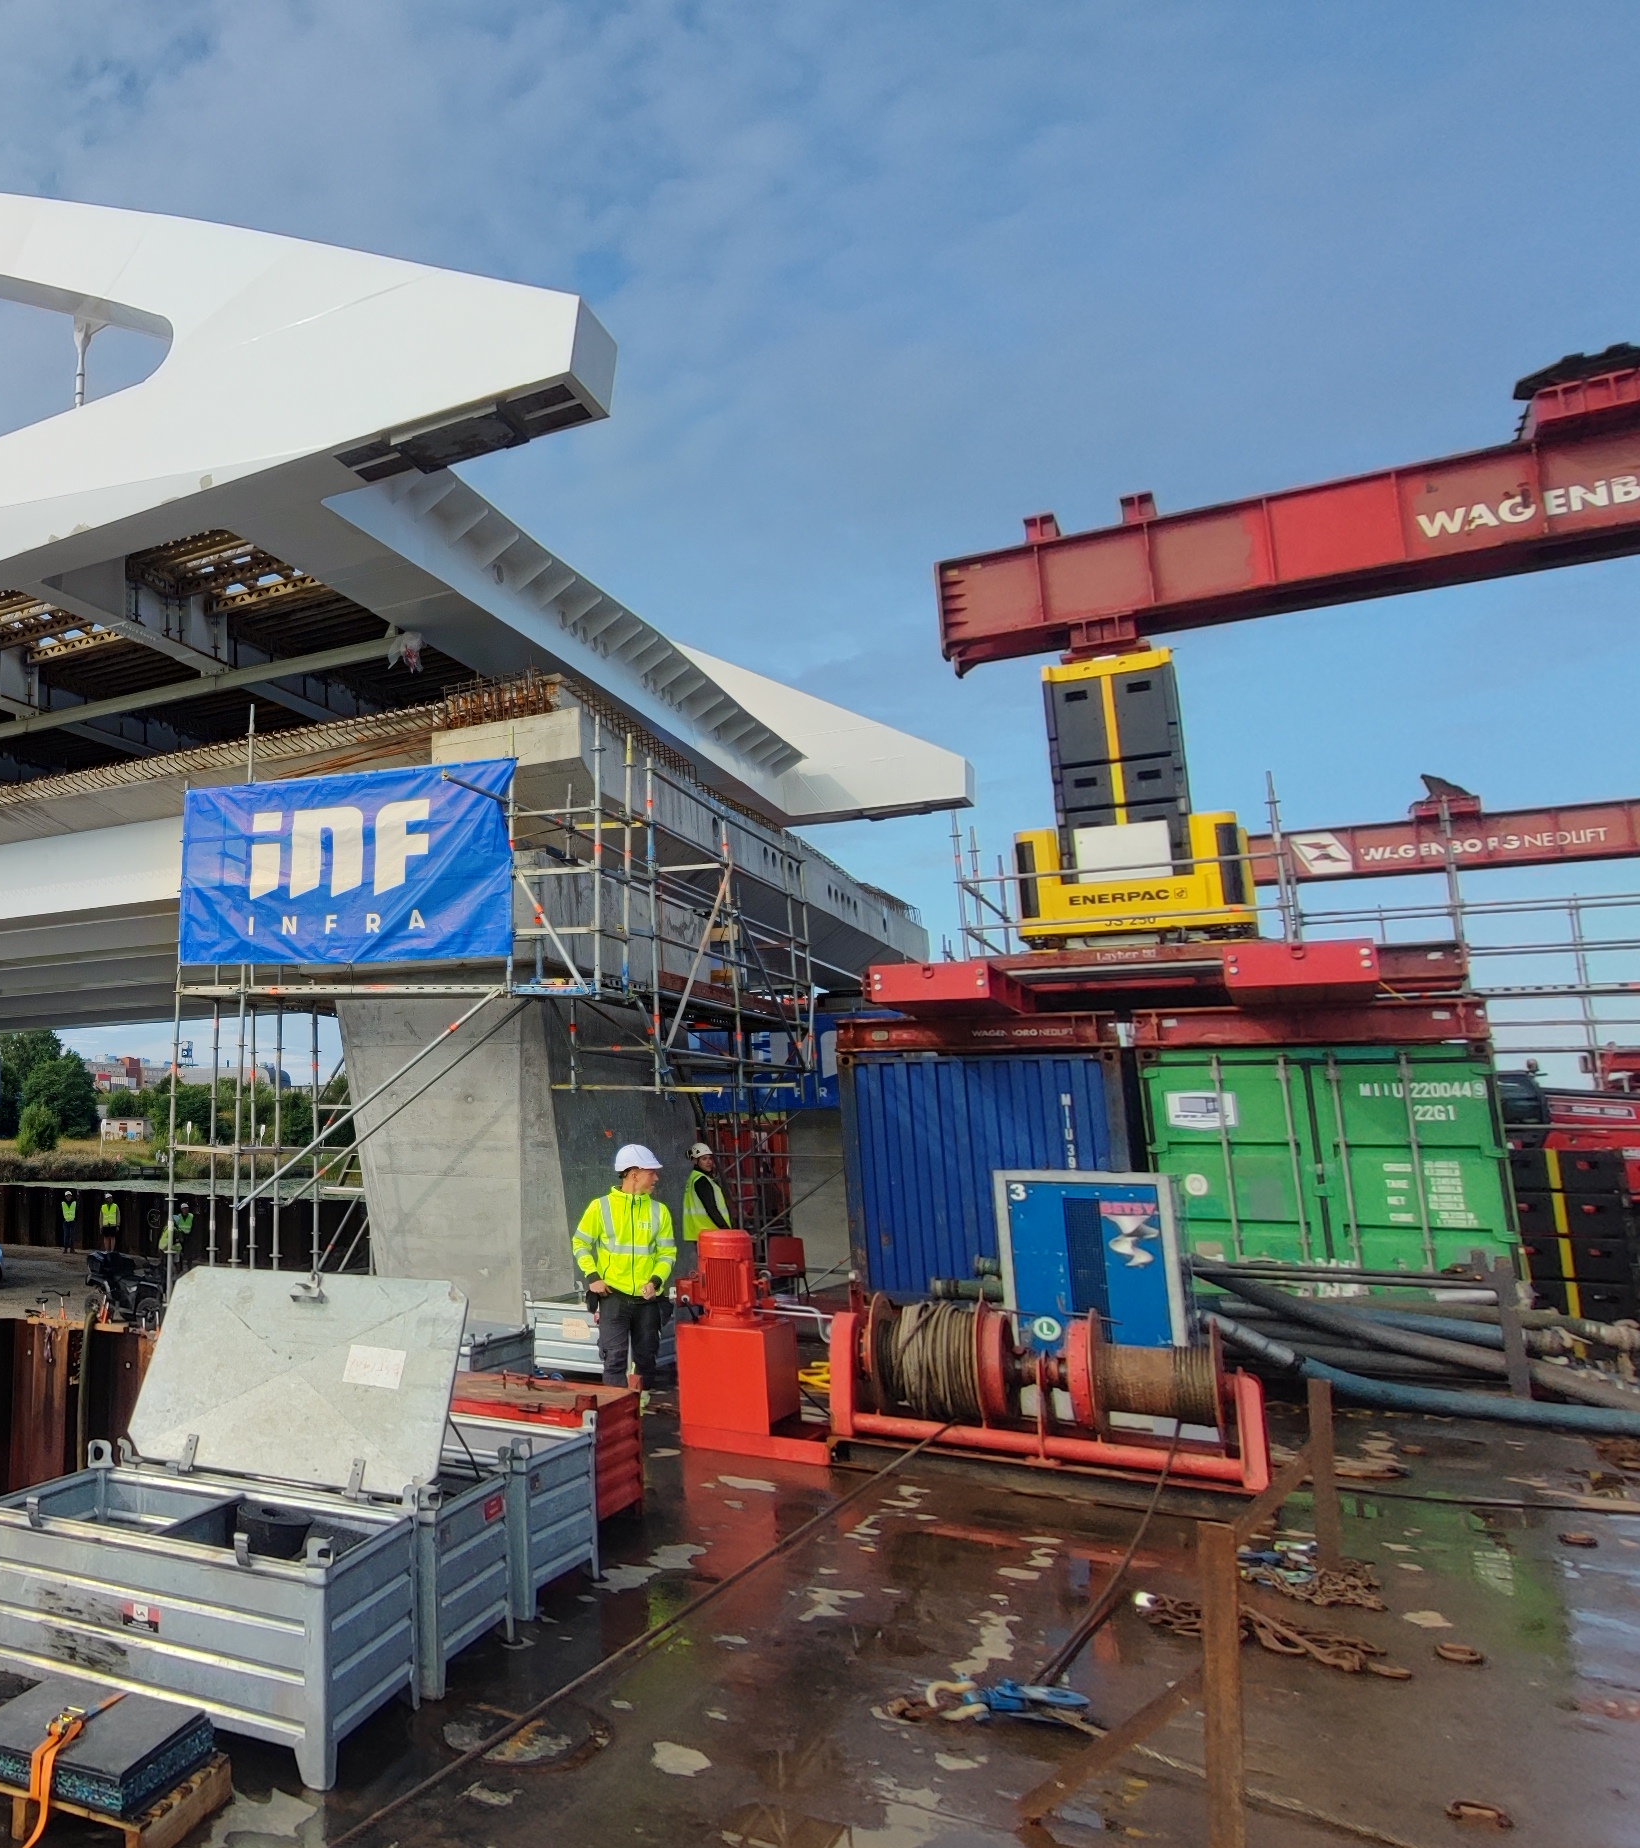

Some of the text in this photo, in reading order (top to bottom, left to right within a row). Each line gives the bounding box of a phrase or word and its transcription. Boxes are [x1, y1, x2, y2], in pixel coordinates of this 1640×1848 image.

[1523, 827, 1608, 848] NEDLIFT
[1068, 889, 1170, 906] ENERPAC
[248, 909, 426, 936] INFRA
[1413, 1105, 1457, 1121] 22G1
[1010, 1183, 1027, 1201] 3
